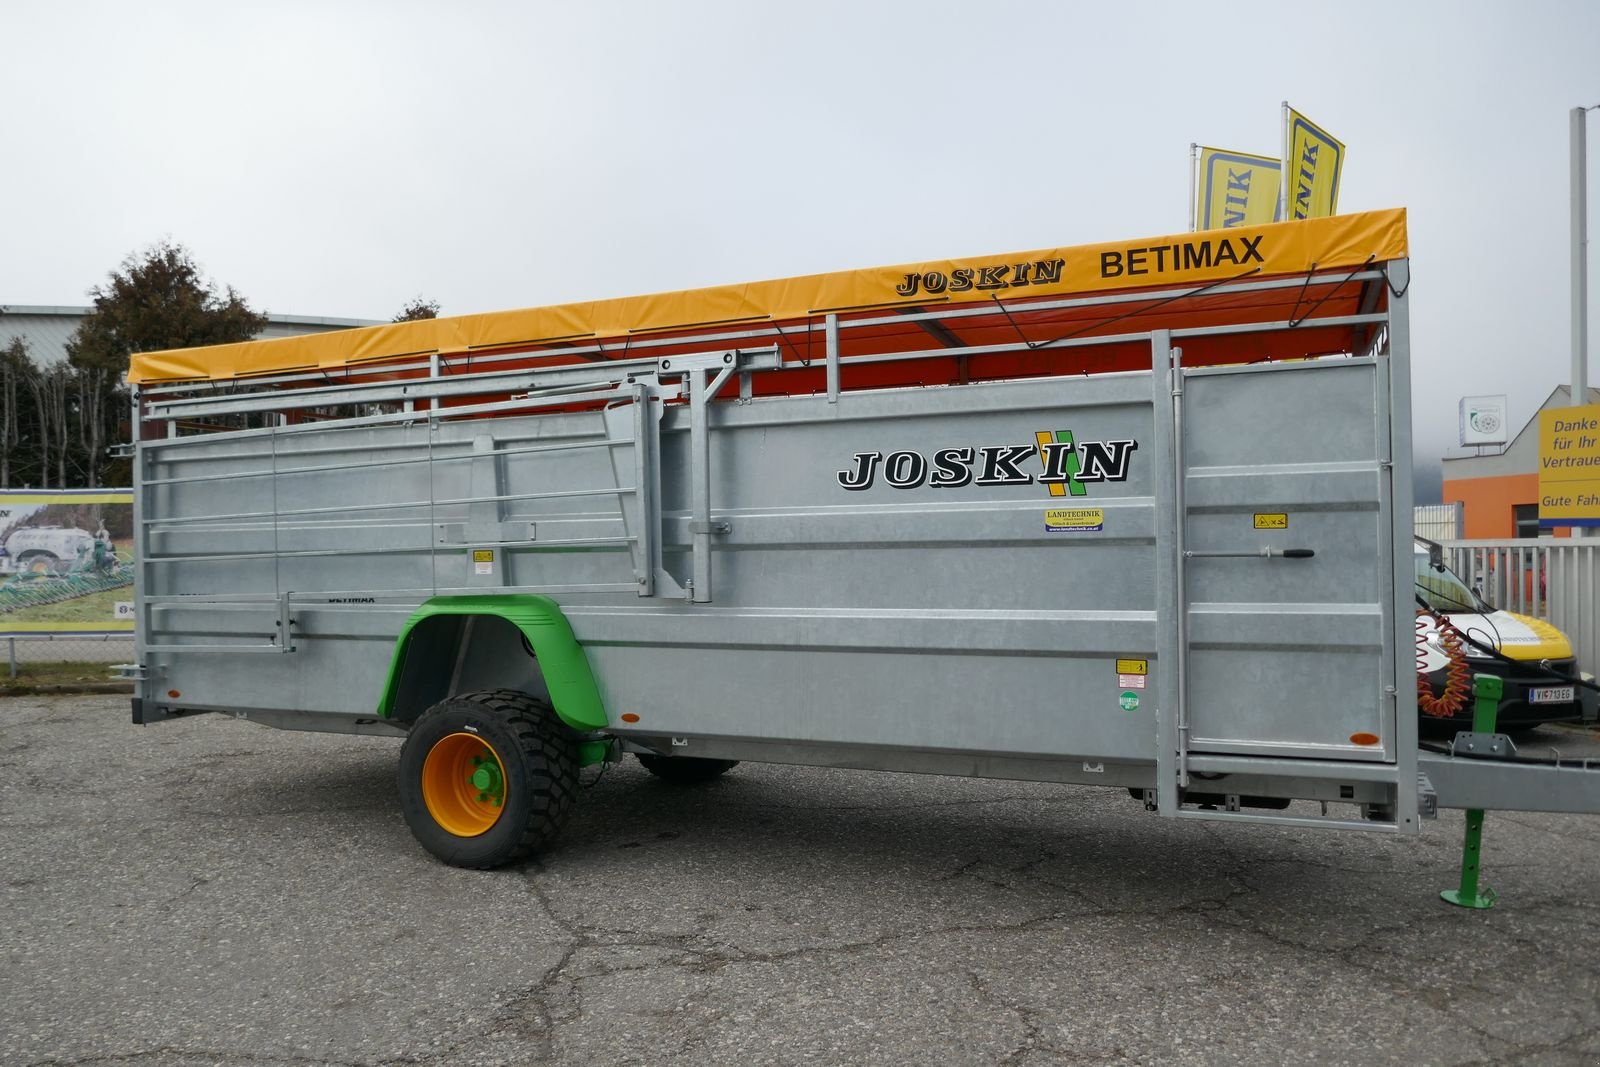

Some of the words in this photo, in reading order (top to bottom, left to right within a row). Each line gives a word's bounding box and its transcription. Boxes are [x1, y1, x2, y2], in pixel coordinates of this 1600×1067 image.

[896, 258, 1065, 297] JOSKIN
[1101, 235, 1264, 279] BETIMAX
[1554, 418, 1598, 432] Danke
[1553, 438, 1572, 450] für
[1579, 436, 1597, 448] Ihr
[836, 438, 1139, 490] JOSKIN
[1542, 496, 1571, 507] Gute
[1047, 510, 1100, 518] LANDTECHNIK
